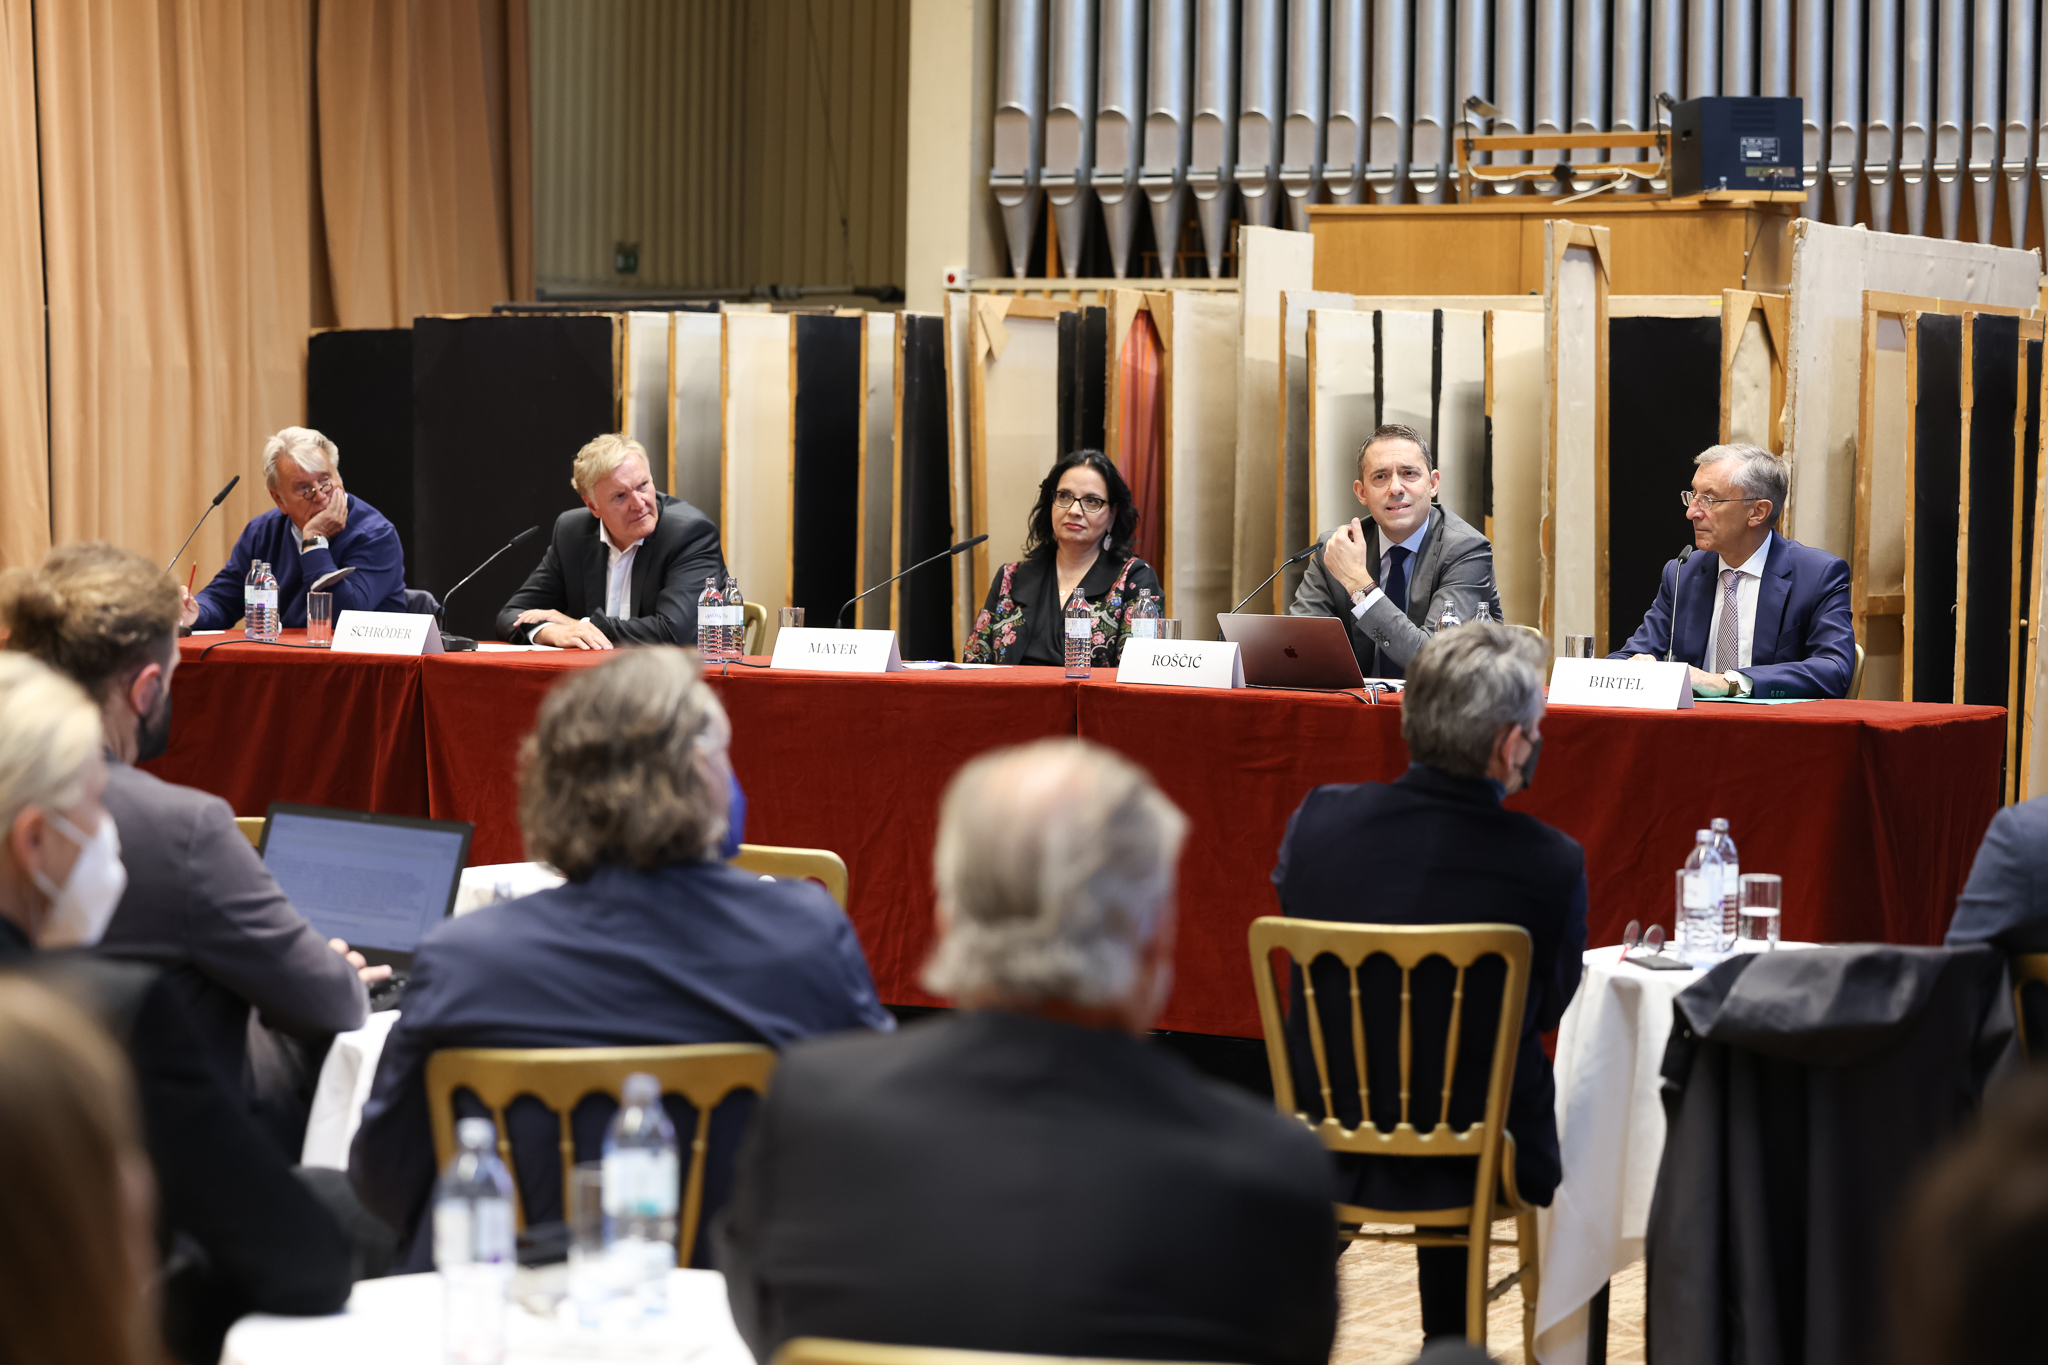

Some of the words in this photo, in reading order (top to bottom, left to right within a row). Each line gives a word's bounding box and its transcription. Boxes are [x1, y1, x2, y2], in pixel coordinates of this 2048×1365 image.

[350, 626, 412, 639] SCHRÖDER
[808, 642, 858, 655] MAYER
[1152, 653, 1202, 669] ROŠČIĆ
[1589, 675, 1644, 691] BIRTEL
